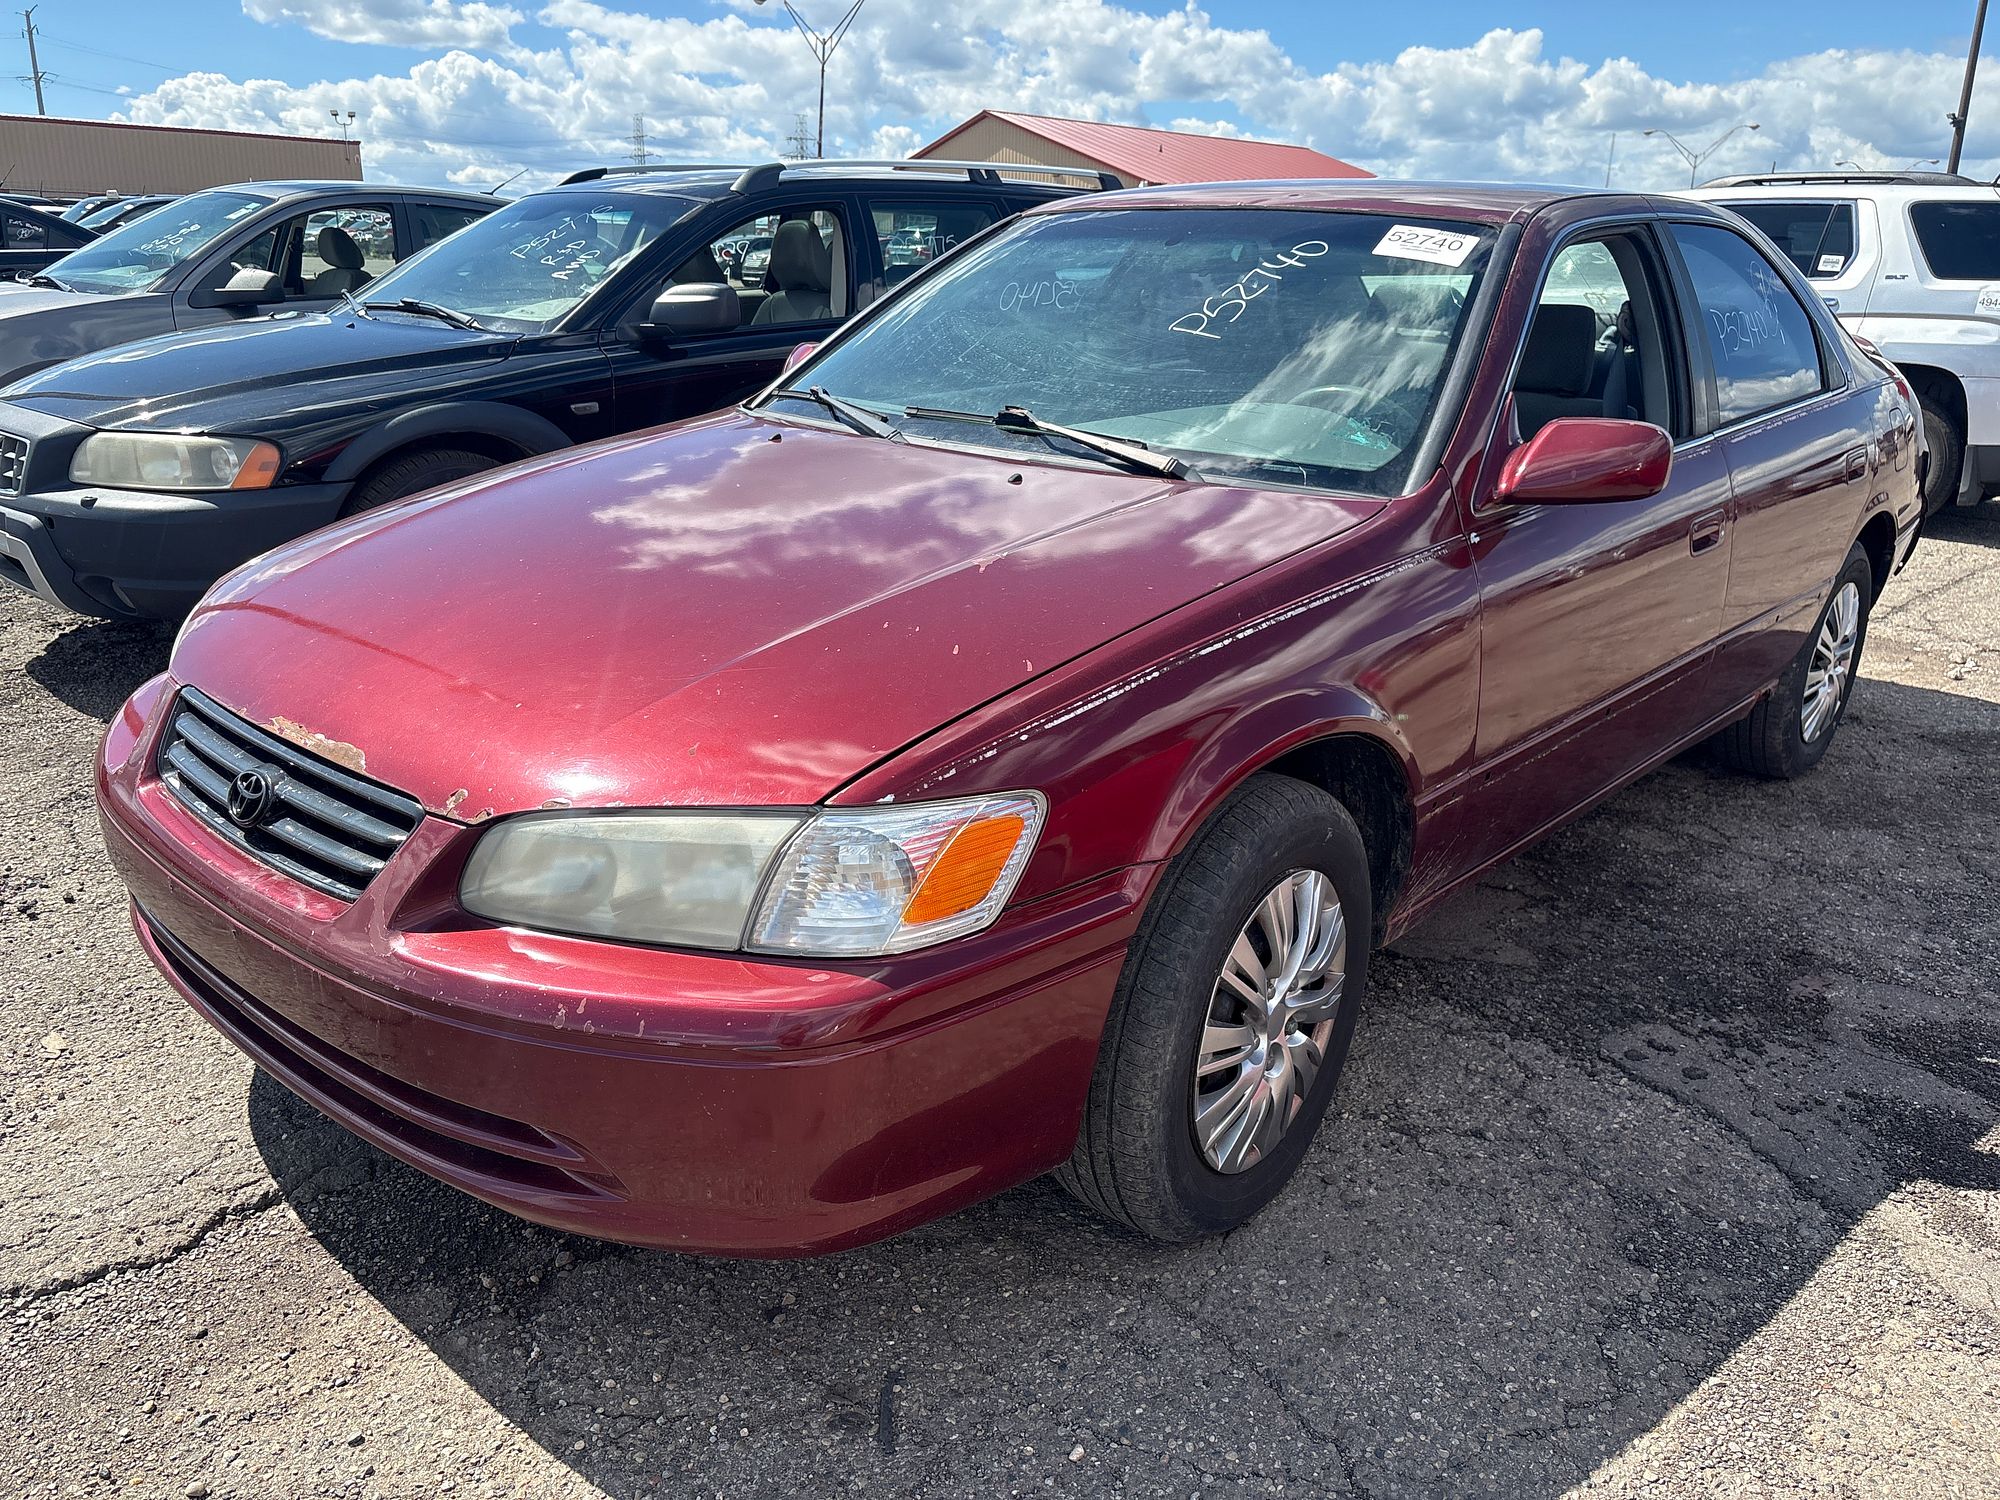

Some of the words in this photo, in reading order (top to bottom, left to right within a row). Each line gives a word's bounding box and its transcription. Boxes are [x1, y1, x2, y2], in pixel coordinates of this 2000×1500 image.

[1388, 231, 1464, 251] 52740
[551, 250, 601, 280] AWD
[1168, 240, 1329, 339] P52740
[1979, 297, 2000, 307] 494
[1709, 308, 1768, 361] P52740
